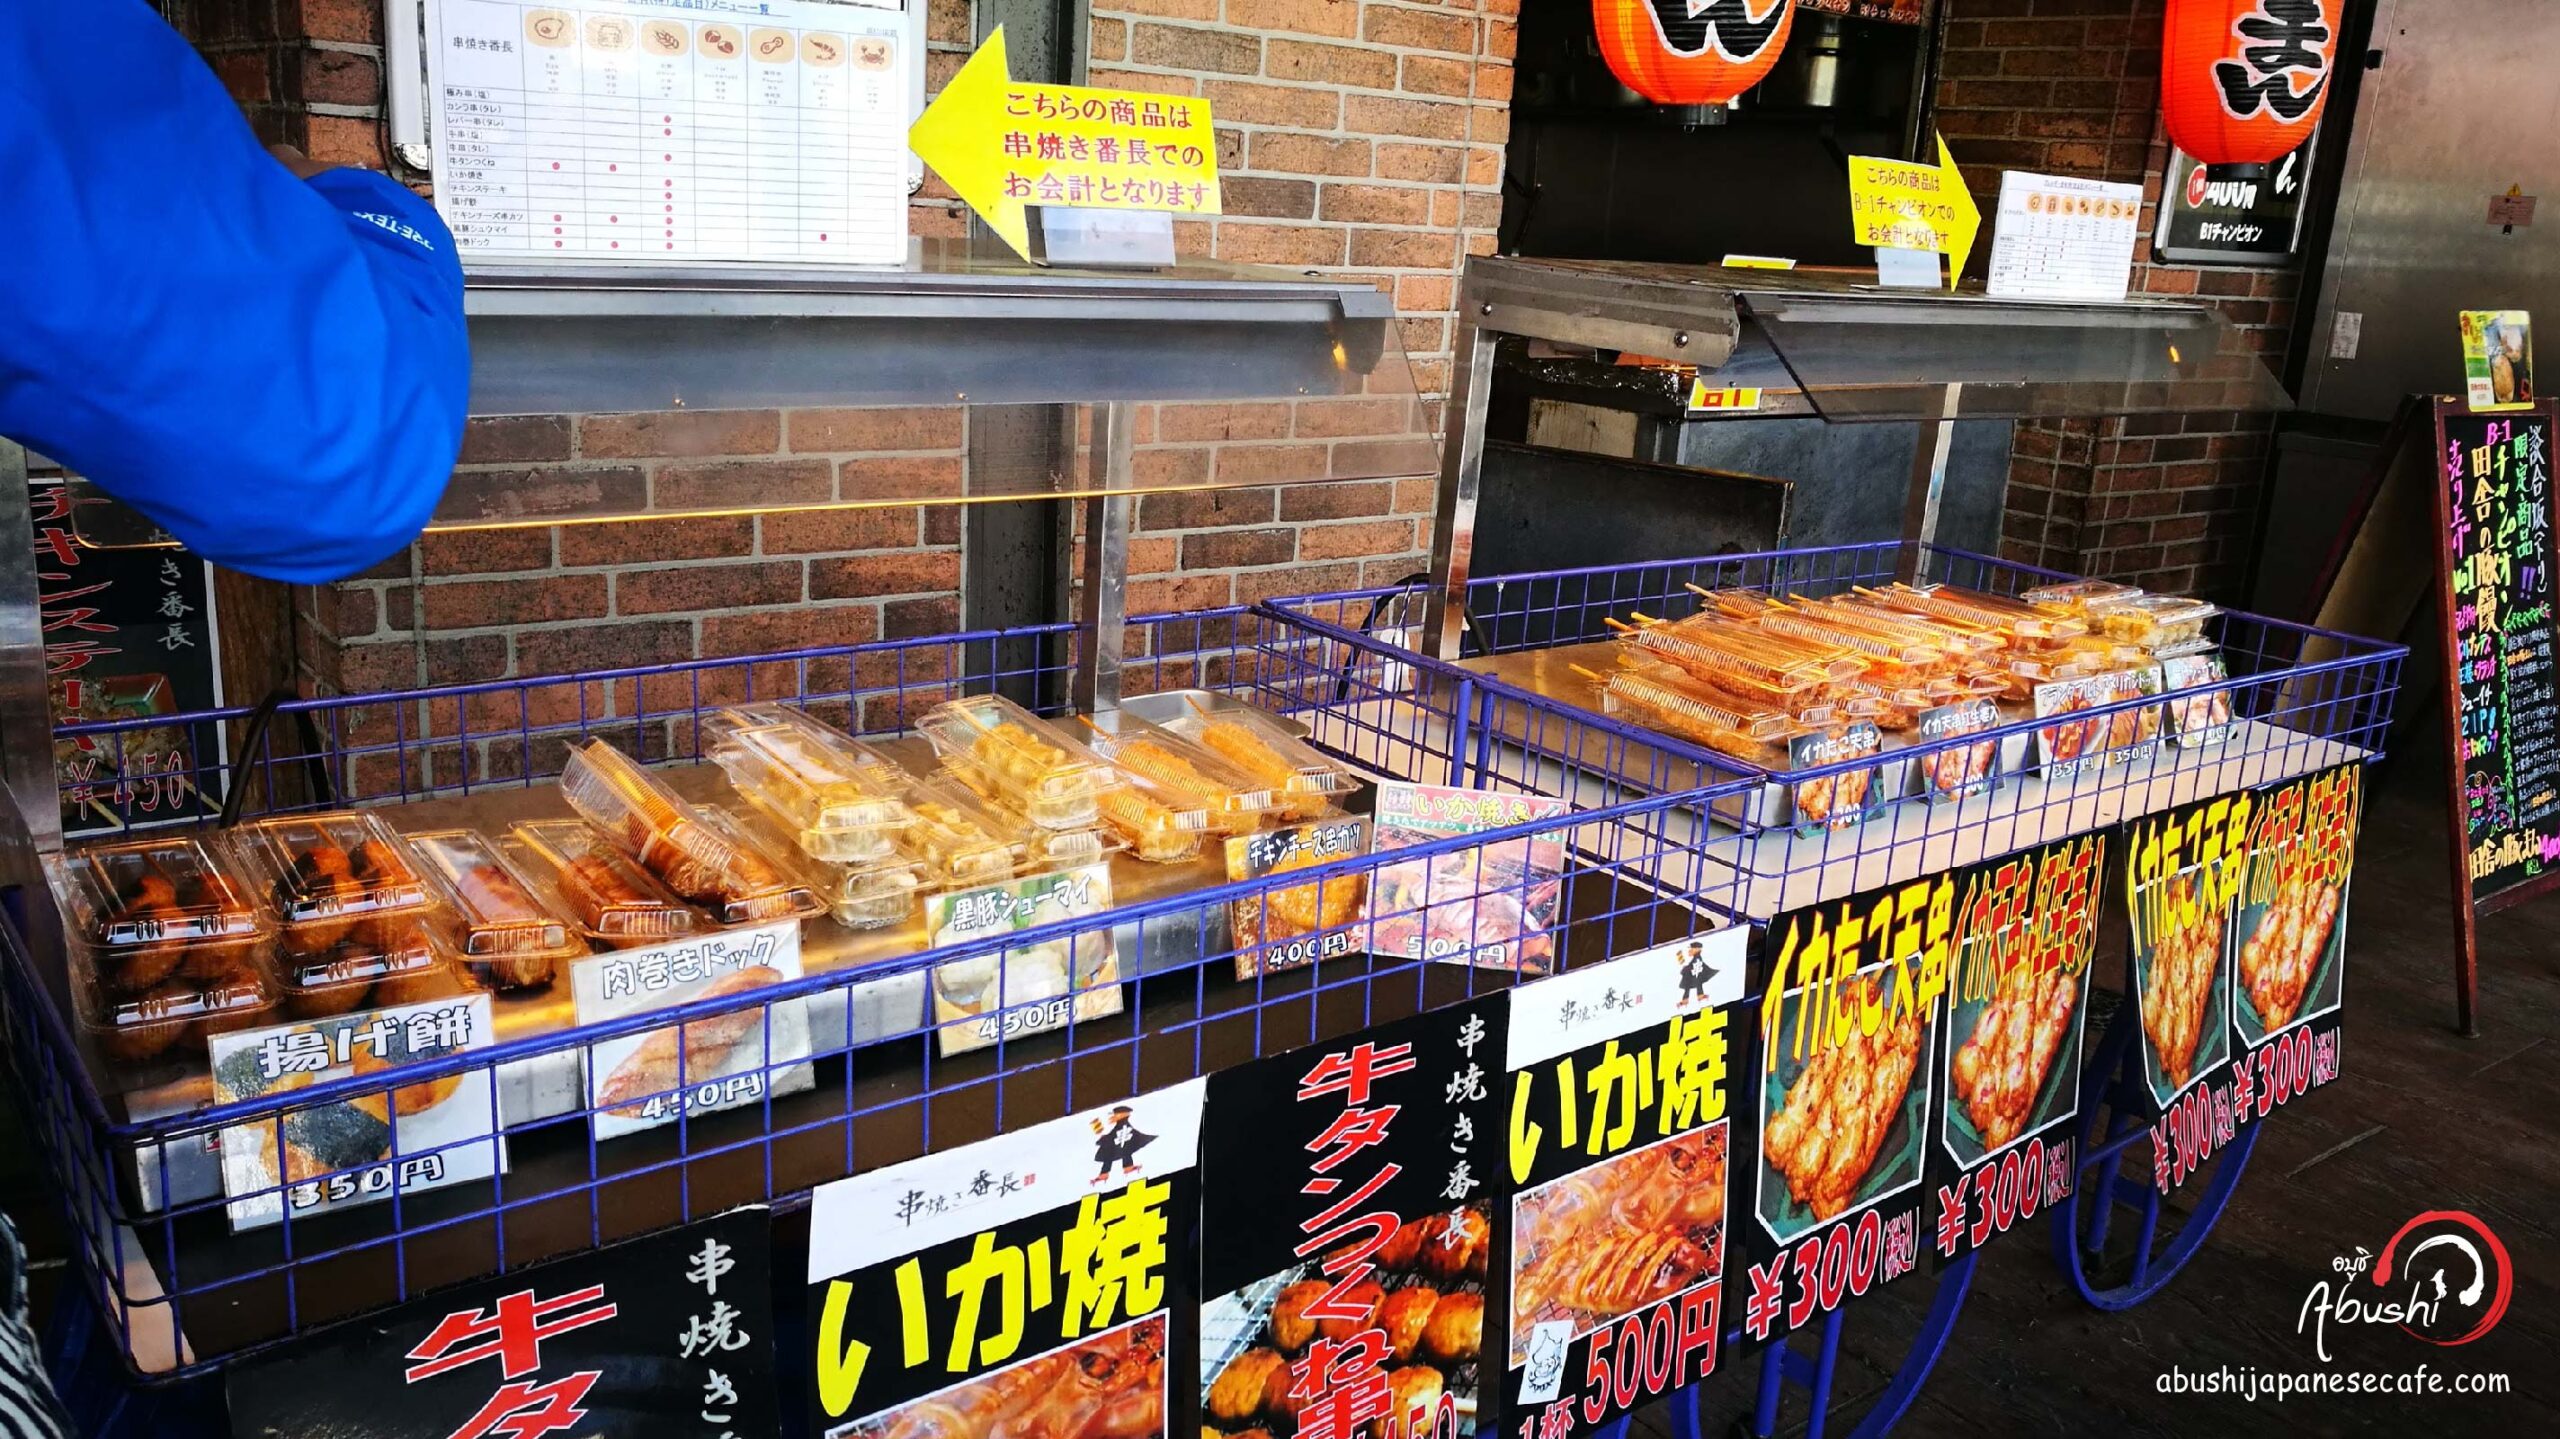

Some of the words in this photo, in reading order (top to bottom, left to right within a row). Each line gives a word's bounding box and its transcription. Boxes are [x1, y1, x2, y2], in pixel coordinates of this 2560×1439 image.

[452, 36, 514, 53] 串焼き番長
[1006, 92, 1193, 129] こちらの商品は
[1004, 131, 1204, 168] 串焼き番長での
[1004, 171, 1211, 207] お会計となります
[1866, 166, 1941, 193] こちらの商品は
[1866, 222, 1949, 248] お会計となります
[2199, 222, 2263, 242] B1チャンピオン
[2486, 418, 2514, 447] B-1
[1800, 730, 1876, 763] イカたこ天串
[2114, 745, 2153, 765] 350円
[69, 749, 185, 823] ¥450
[2127, 790, 2253, 957] イカたこ天串
[953, 874, 1093, 932] 黒豚シューマイ
[602, 933, 777, 1000] 肉巻きドック
[1267, 932, 1350, 968] 400円
[1407, 935, 1508, 964] 500円
[1760, 873, 1956, 1074] イカたこ天串
[978, 1000, 1078, 1040] 450円
[1558, 985, 1636, 1032] 串焼き番長
[258, 1005, 472, 1080] 揚げ餅
[640, 1072, 765, 1120] 450円
[1509, 1005, 1731, 1186] いか焼
[1434, 1013, 1488, 1252] 串焼き番長
[291, 1153, 445, 1210] 350円
[894, 1168, 1024, 1227] 串焼き番長
[1286, 1040, 1418, 1439] 牛タンつくね串
[816, 1177, 1172, 1418] いか焼
[679, 1237, 751, 1439] 串焼き
[1583, 1281, 1722, 1424] 500円
